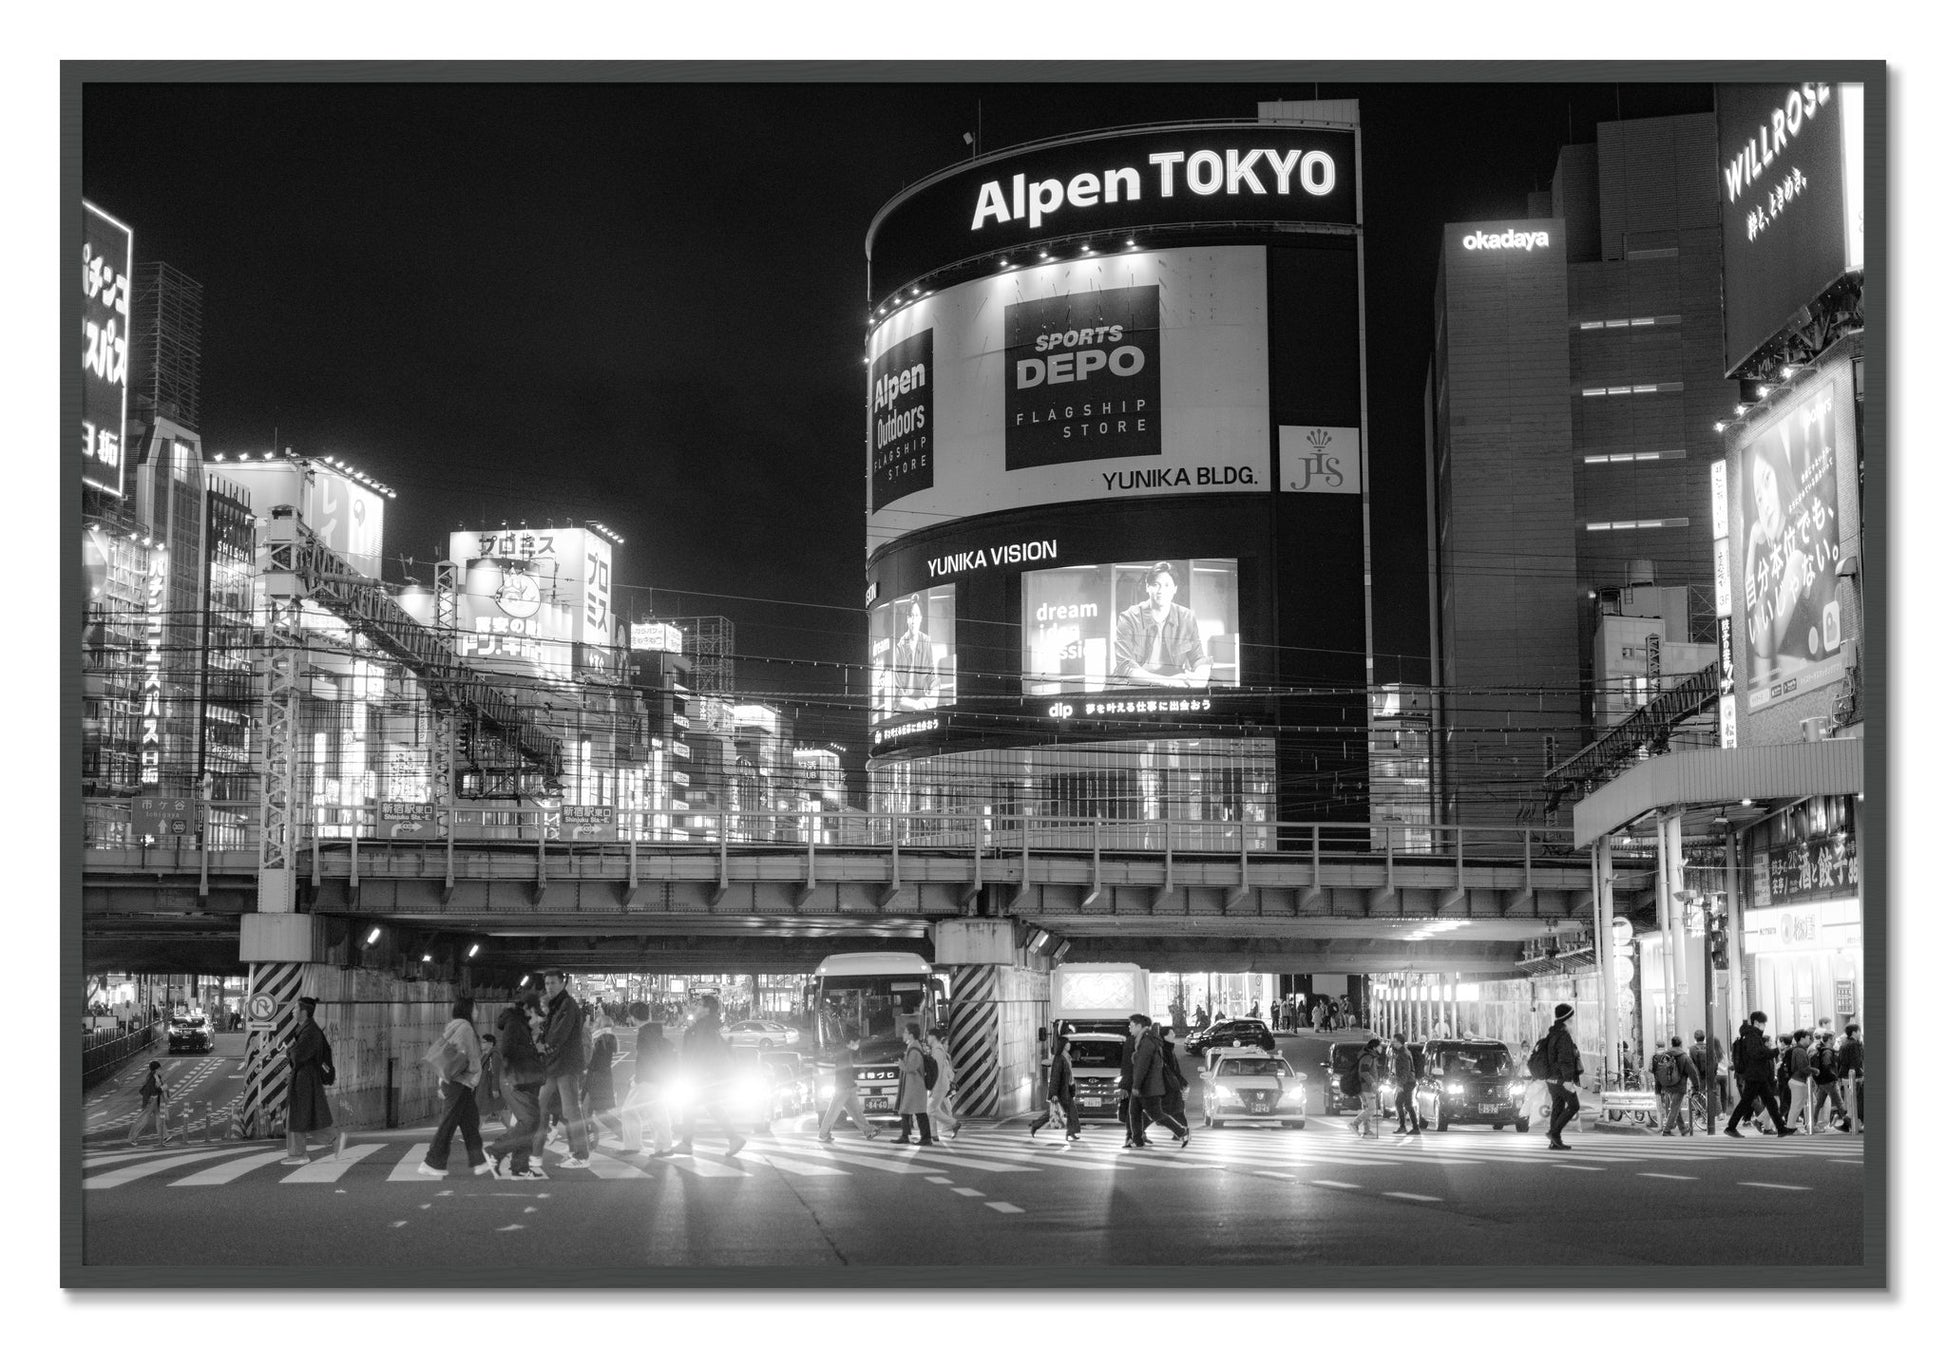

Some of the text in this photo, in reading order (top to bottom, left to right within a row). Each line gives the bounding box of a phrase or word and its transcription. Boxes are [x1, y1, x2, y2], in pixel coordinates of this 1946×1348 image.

[970, 149, 1336, 230] Alpen TOKYO
[1463, 229, 1549, 251] okadaya
[1035, 325, 1123, 352] SPORTS
[1017, 345, 1145, 389] DEPO
[874, 363, 925, 413] Alpen
[1017, 400, 1145, 425] FLAGSHIP
[877, 405, 925, 449] Outdoors
[1063, 419, 1146, 438] STORE
[874, 437, 926, 472] FLAGSHIP
[888, 455, 926, 480] STORE
[1102, 466, 1258, 491] YUNIKA BLDG.
[217, 541, 249, 563] SHISHA
[478, 536, 555, 556] プロミス
[927, 539, 1058, 578] YUNIKA VISION
[1036, 603, 1098, 621] dream
[1049, 700, 1211, 719] dip 夢を叶える仕事に出会おう
